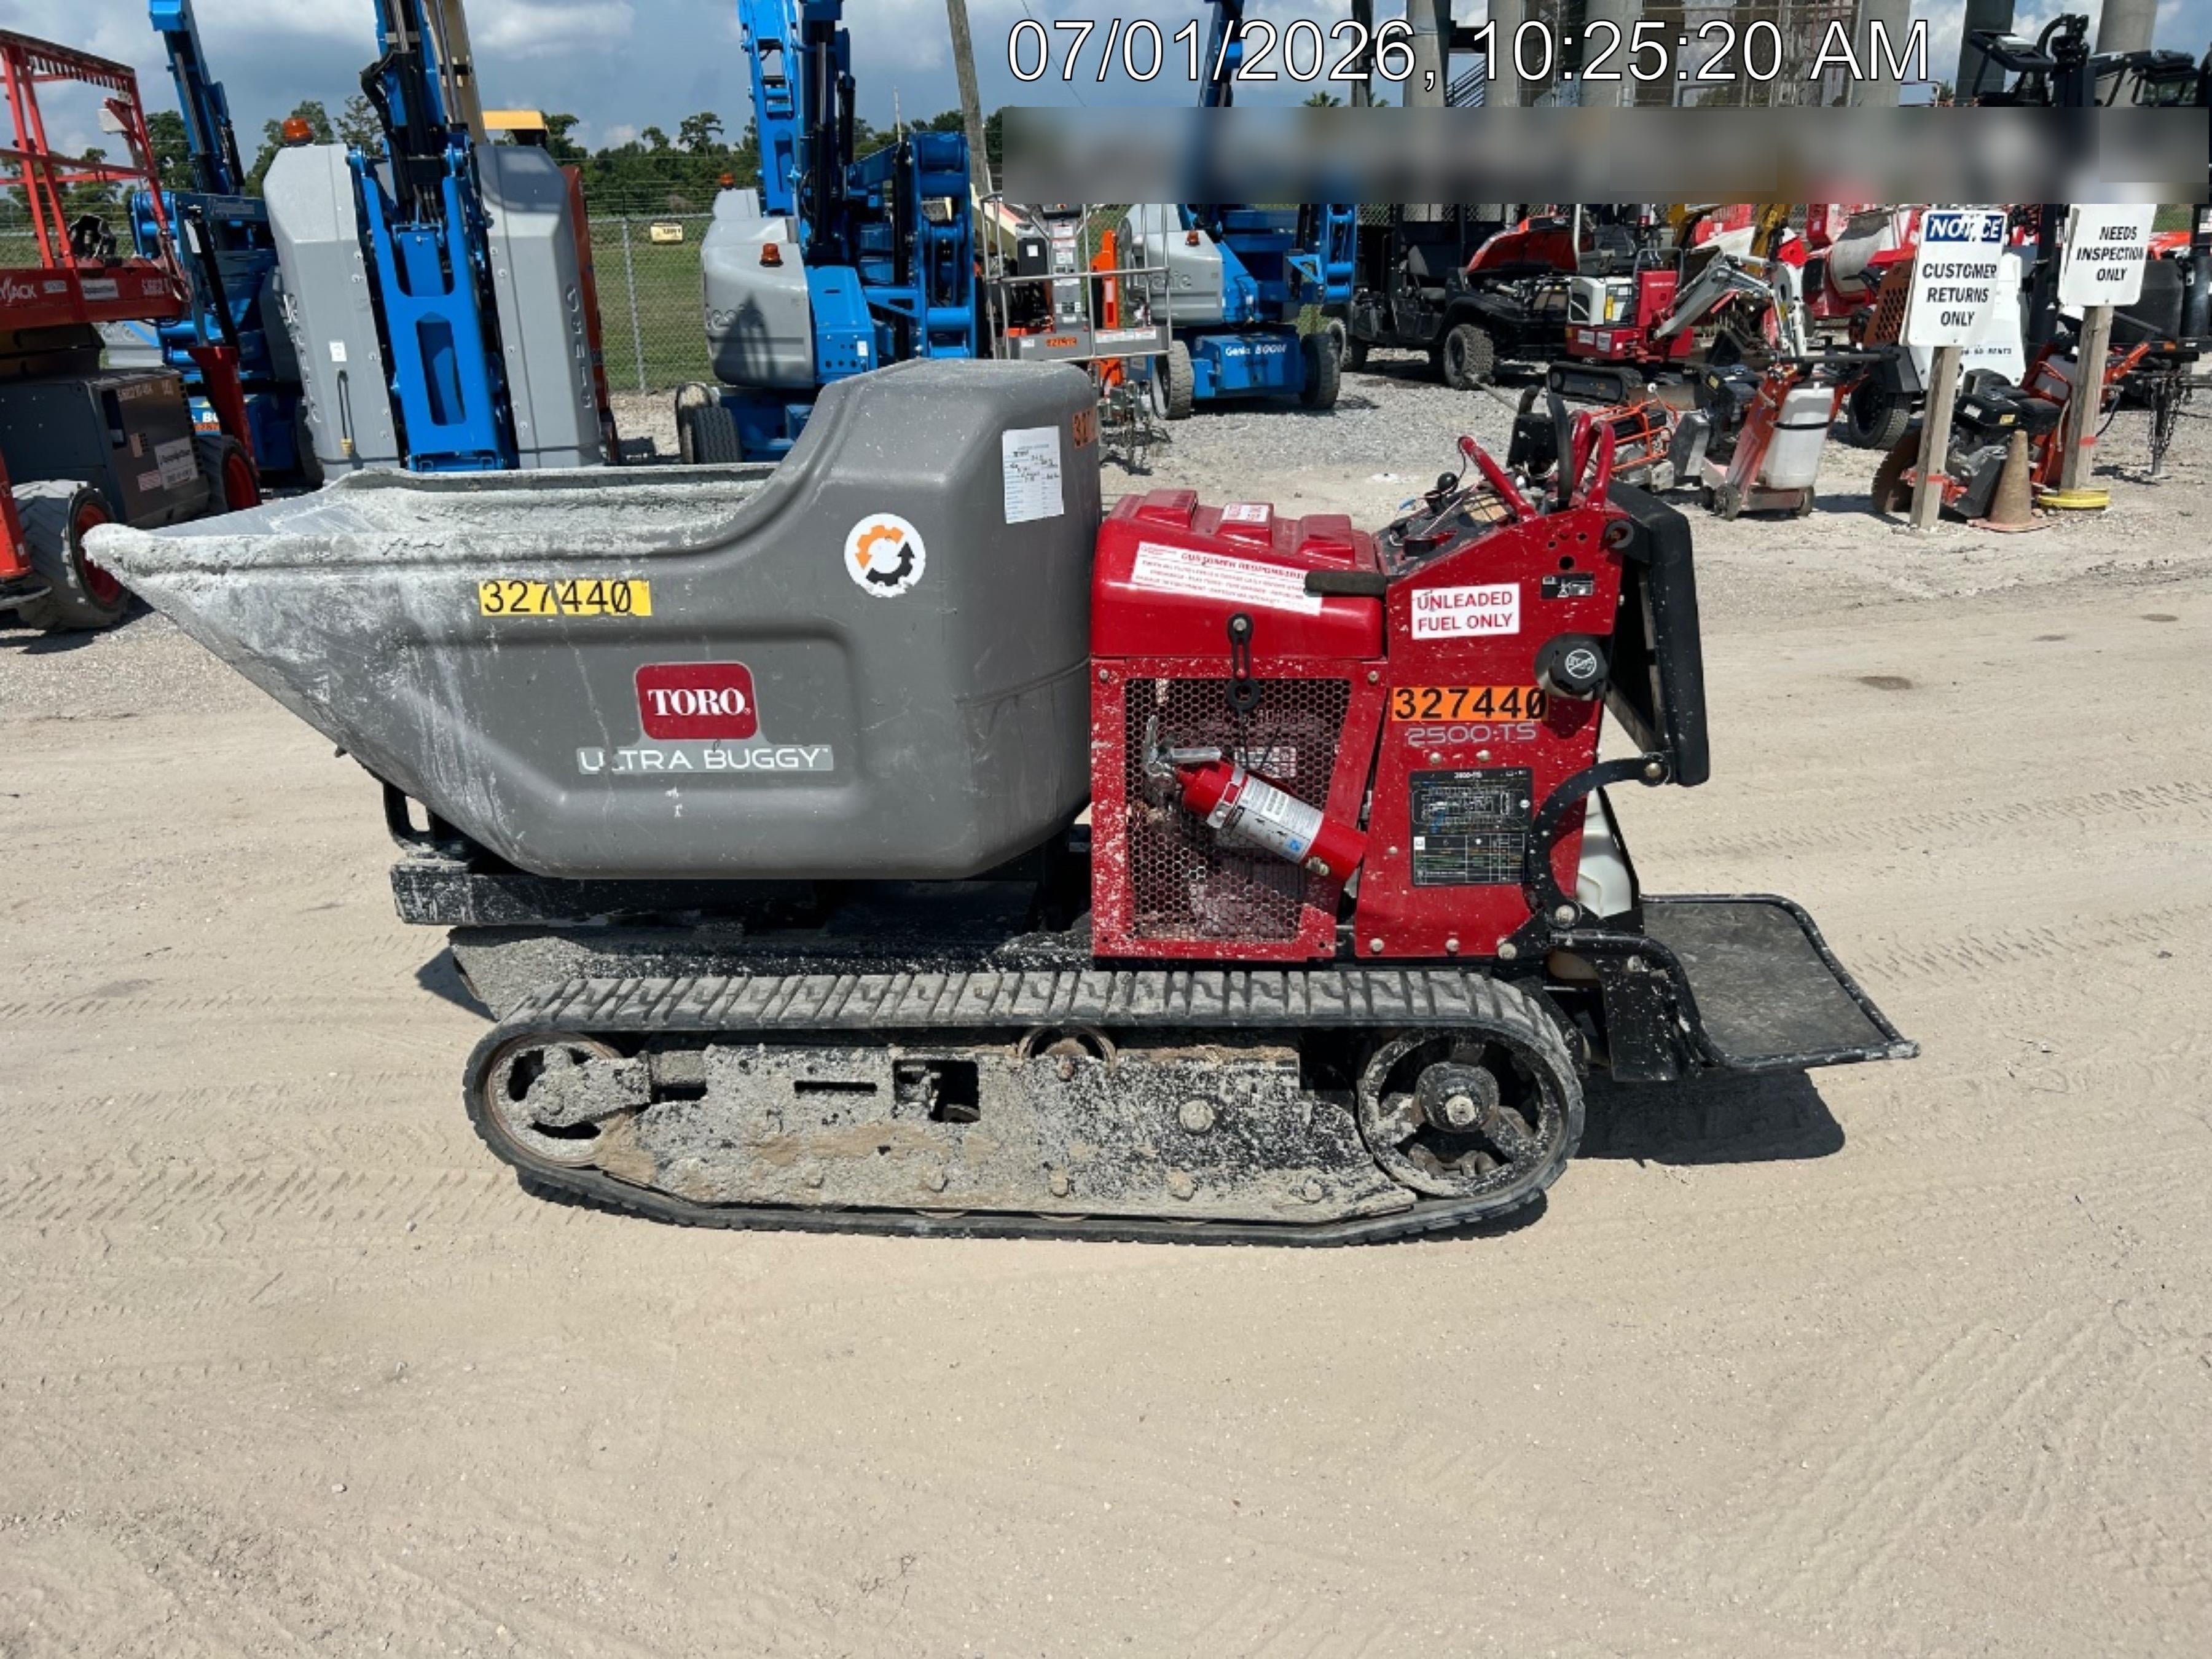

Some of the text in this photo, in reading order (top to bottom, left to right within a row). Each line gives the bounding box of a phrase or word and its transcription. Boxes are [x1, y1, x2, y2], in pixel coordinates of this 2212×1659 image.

[2099, 226, 2137, 241] NEEDS
[2076, 246, 2143, 261] INSPECTION
[1922, 263, 1998, 280] CUSTOMER
[2096, 267, 2127, 281] ONLY
[1926, 287, 1989, 303] RETURNS
[1940, 311, 1975, 326] ONLY
[483, 580, 632, 614] 327440
[1415, 590, 1513, 611] UNLEADED
[1418, 613, 1513, 632] FUEL ONLY
[1395, 687, 1547, 718] 327440
